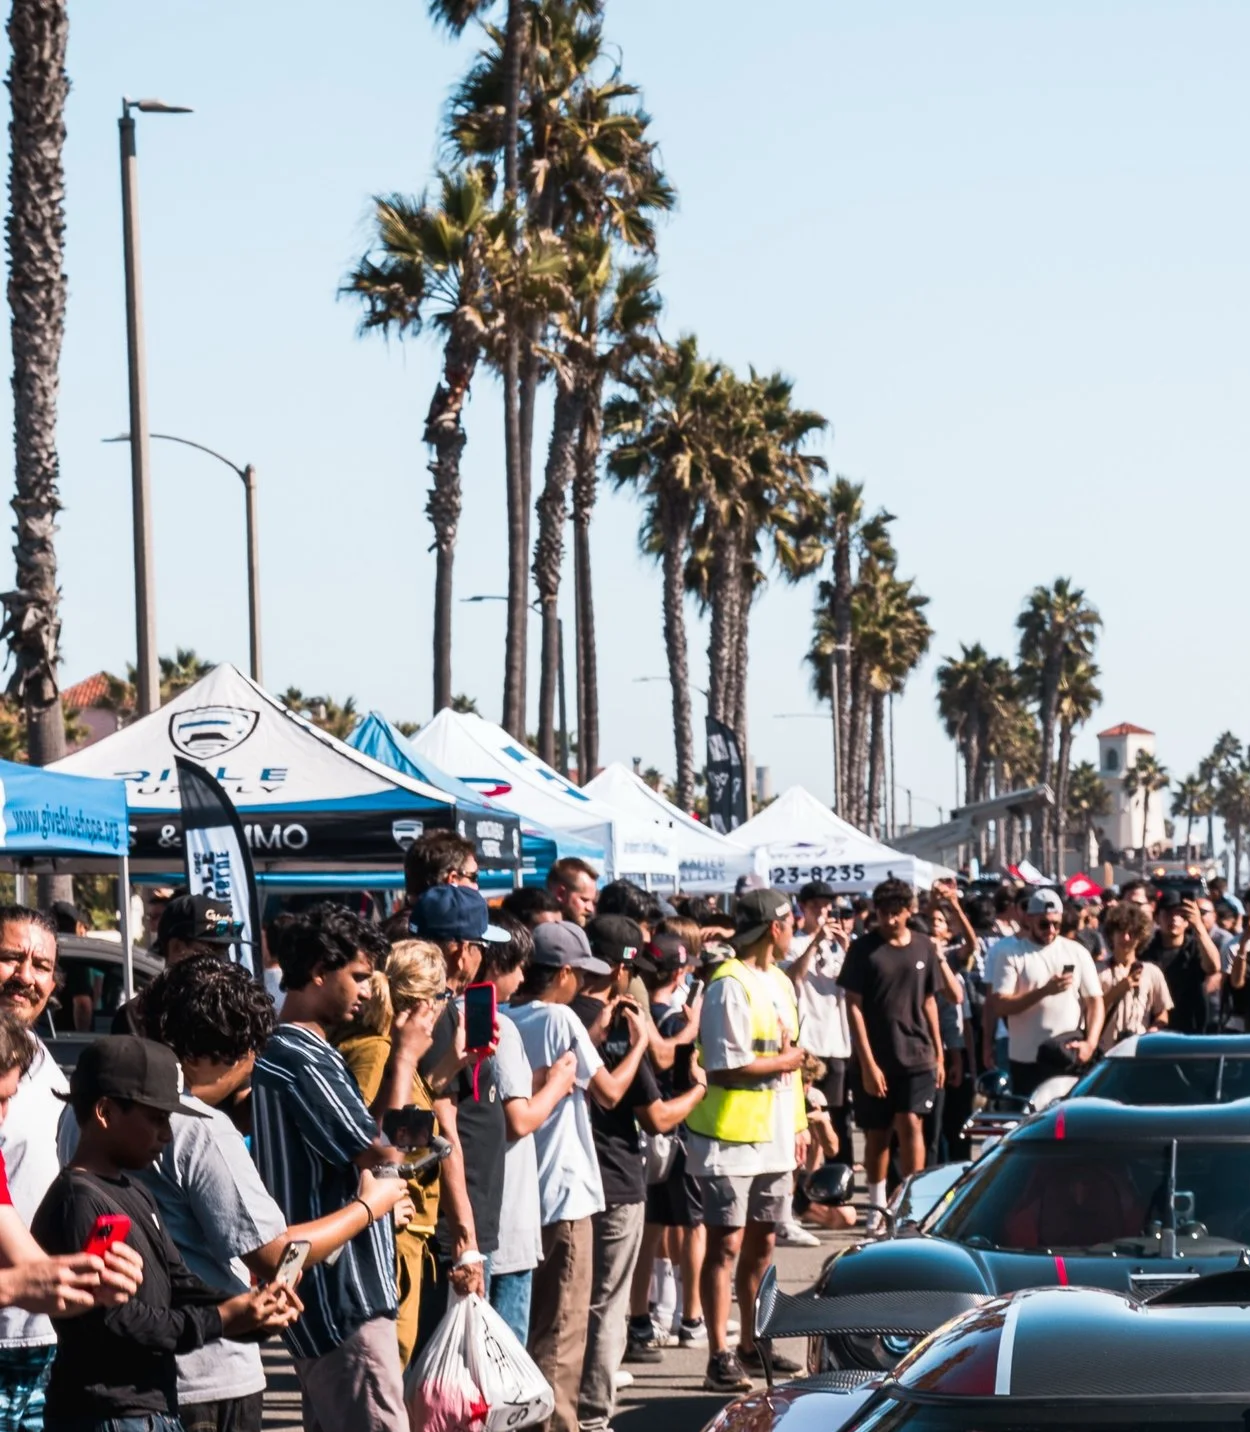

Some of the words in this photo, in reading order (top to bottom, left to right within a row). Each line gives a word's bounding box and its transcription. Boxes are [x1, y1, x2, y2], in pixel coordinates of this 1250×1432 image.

[113, 767, 288, 781] RILE
[12, 803, 120, 849] www.givebluehope.org
[769, 864, 865, 885] 23-8235
